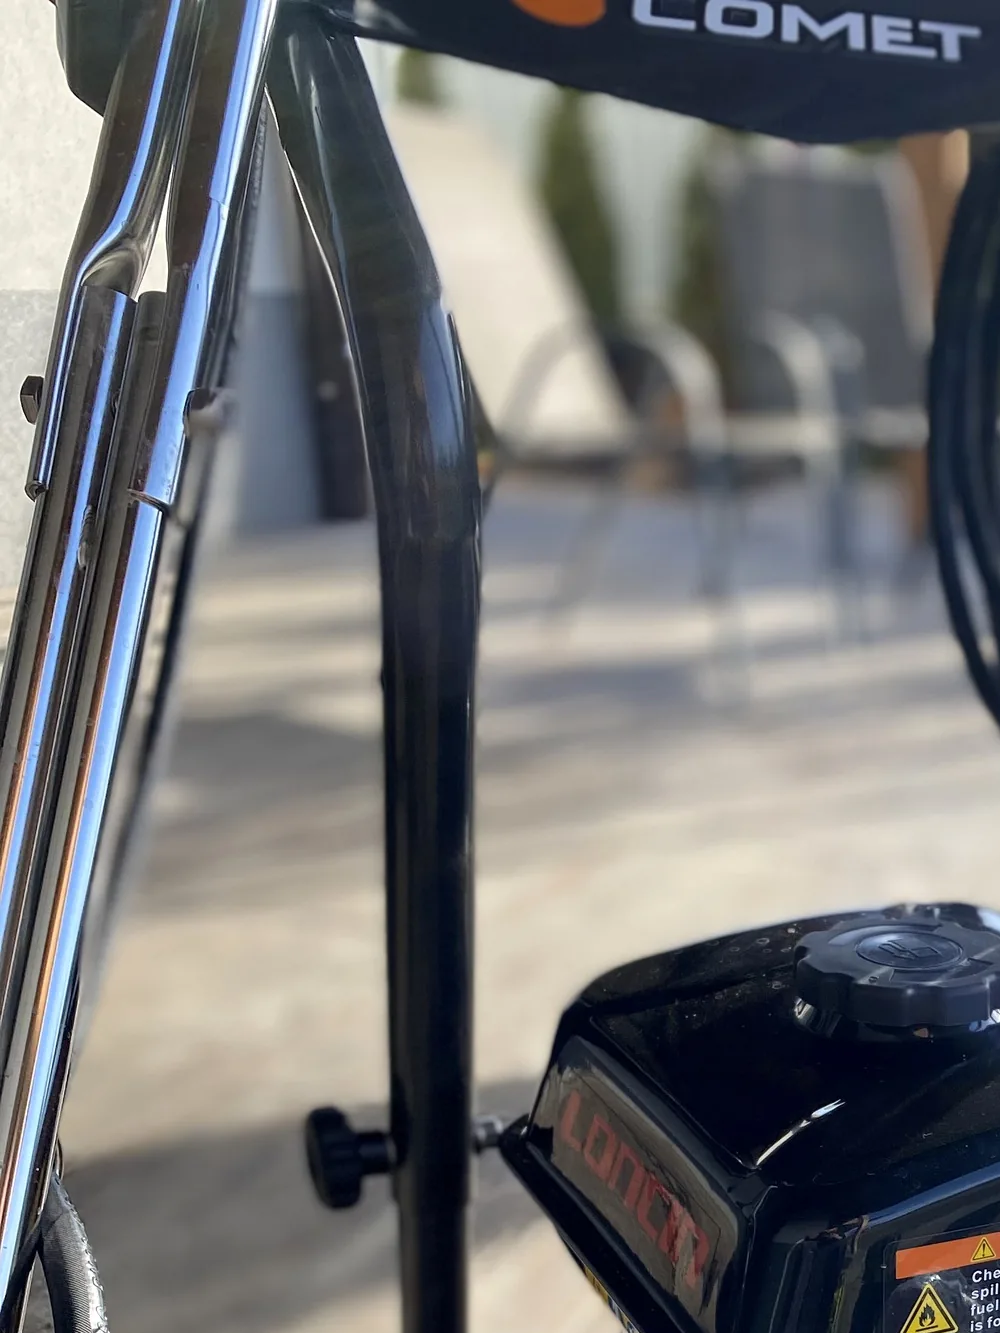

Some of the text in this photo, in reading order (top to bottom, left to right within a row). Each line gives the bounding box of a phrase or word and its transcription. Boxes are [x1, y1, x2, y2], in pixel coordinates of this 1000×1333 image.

[631, 0, 982, 62] COMET
[970, 1298, 999, 1317] fuel
[970, 1320, 983, 1332] is
